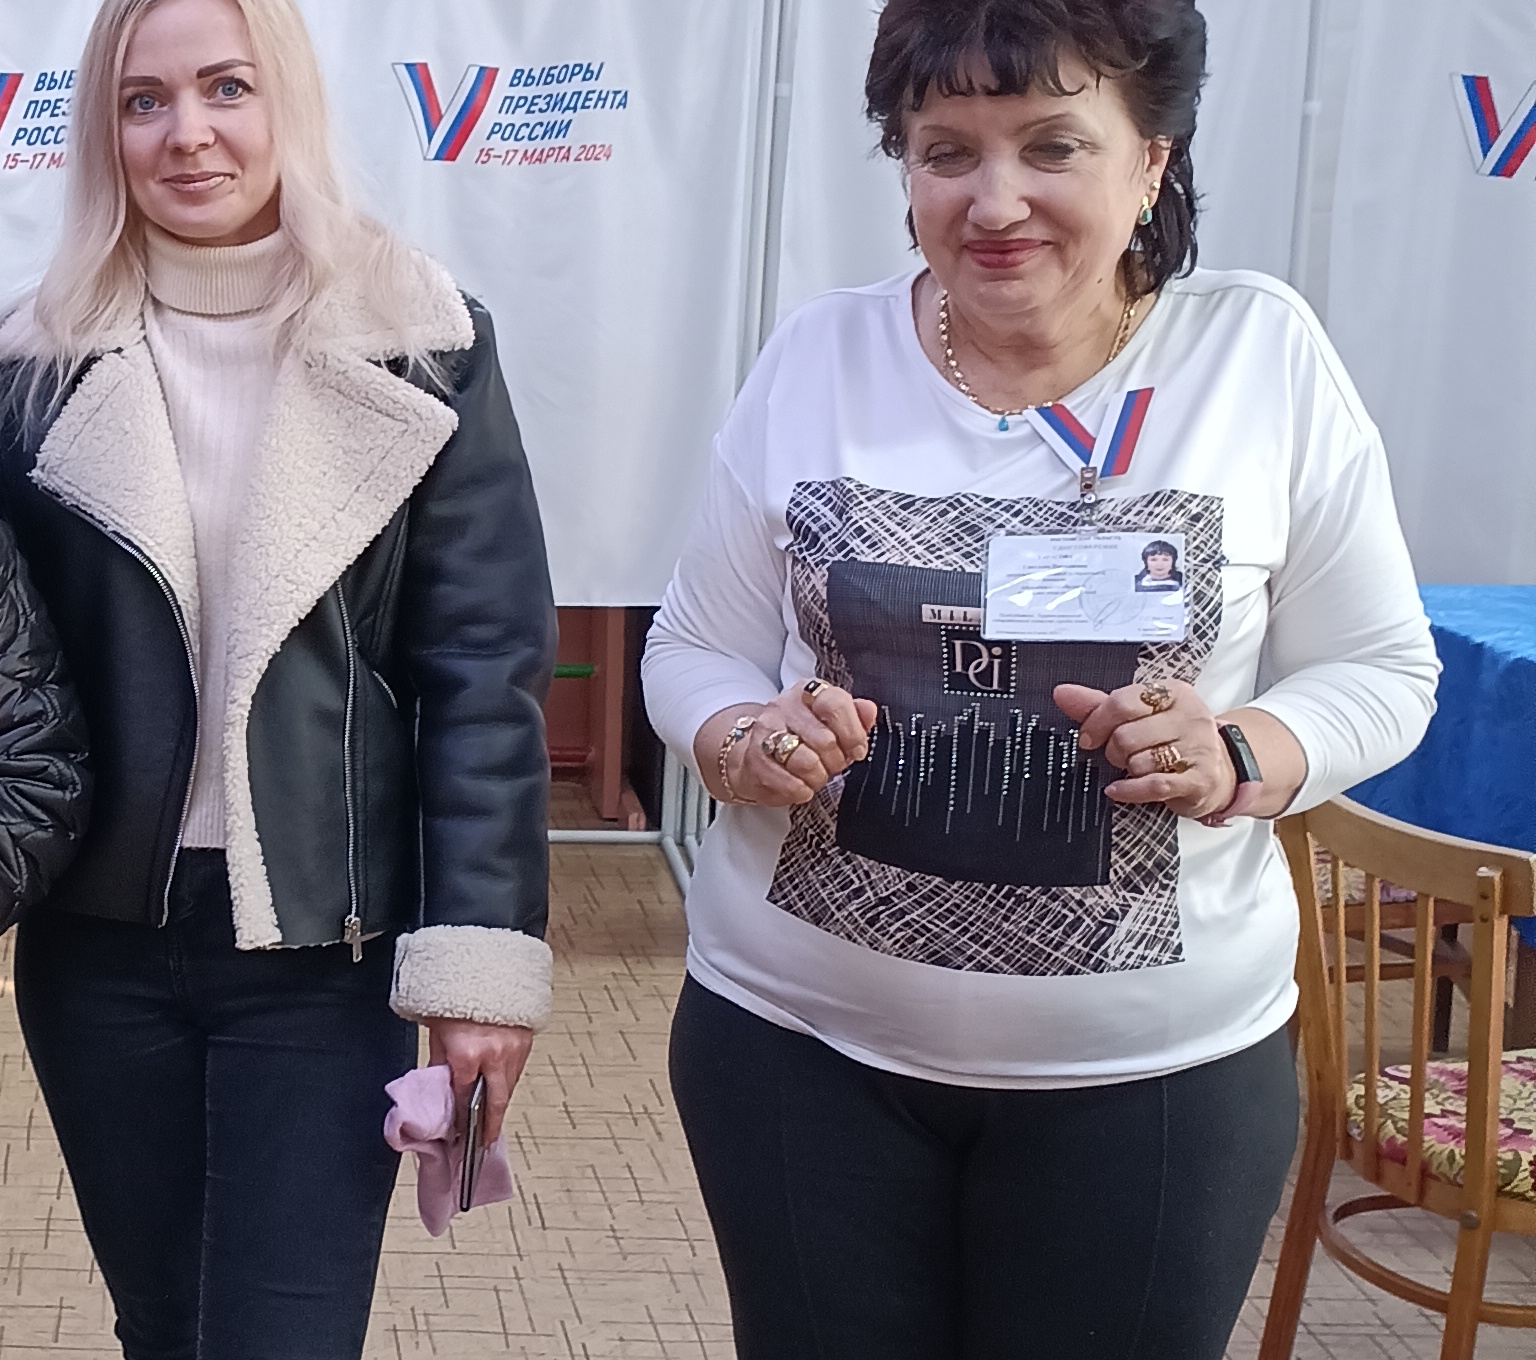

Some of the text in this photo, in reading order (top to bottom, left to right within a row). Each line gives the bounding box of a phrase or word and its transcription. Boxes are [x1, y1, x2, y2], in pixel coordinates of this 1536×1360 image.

[33, 69, 77, 92] ВЫБ
[508, 62, 605, 88] ВЫБОРЫ
[497, 89, 629, 115] ПРЕЗИДЕНТА
[11, 125, 68, 146] РОСС
[486, 119, 573, 142] РОССИИ
[519, 145, 571, 165] МАРТА
[573, 144, 613, 162] 2024
[928, 608, 974, 622] MIL
